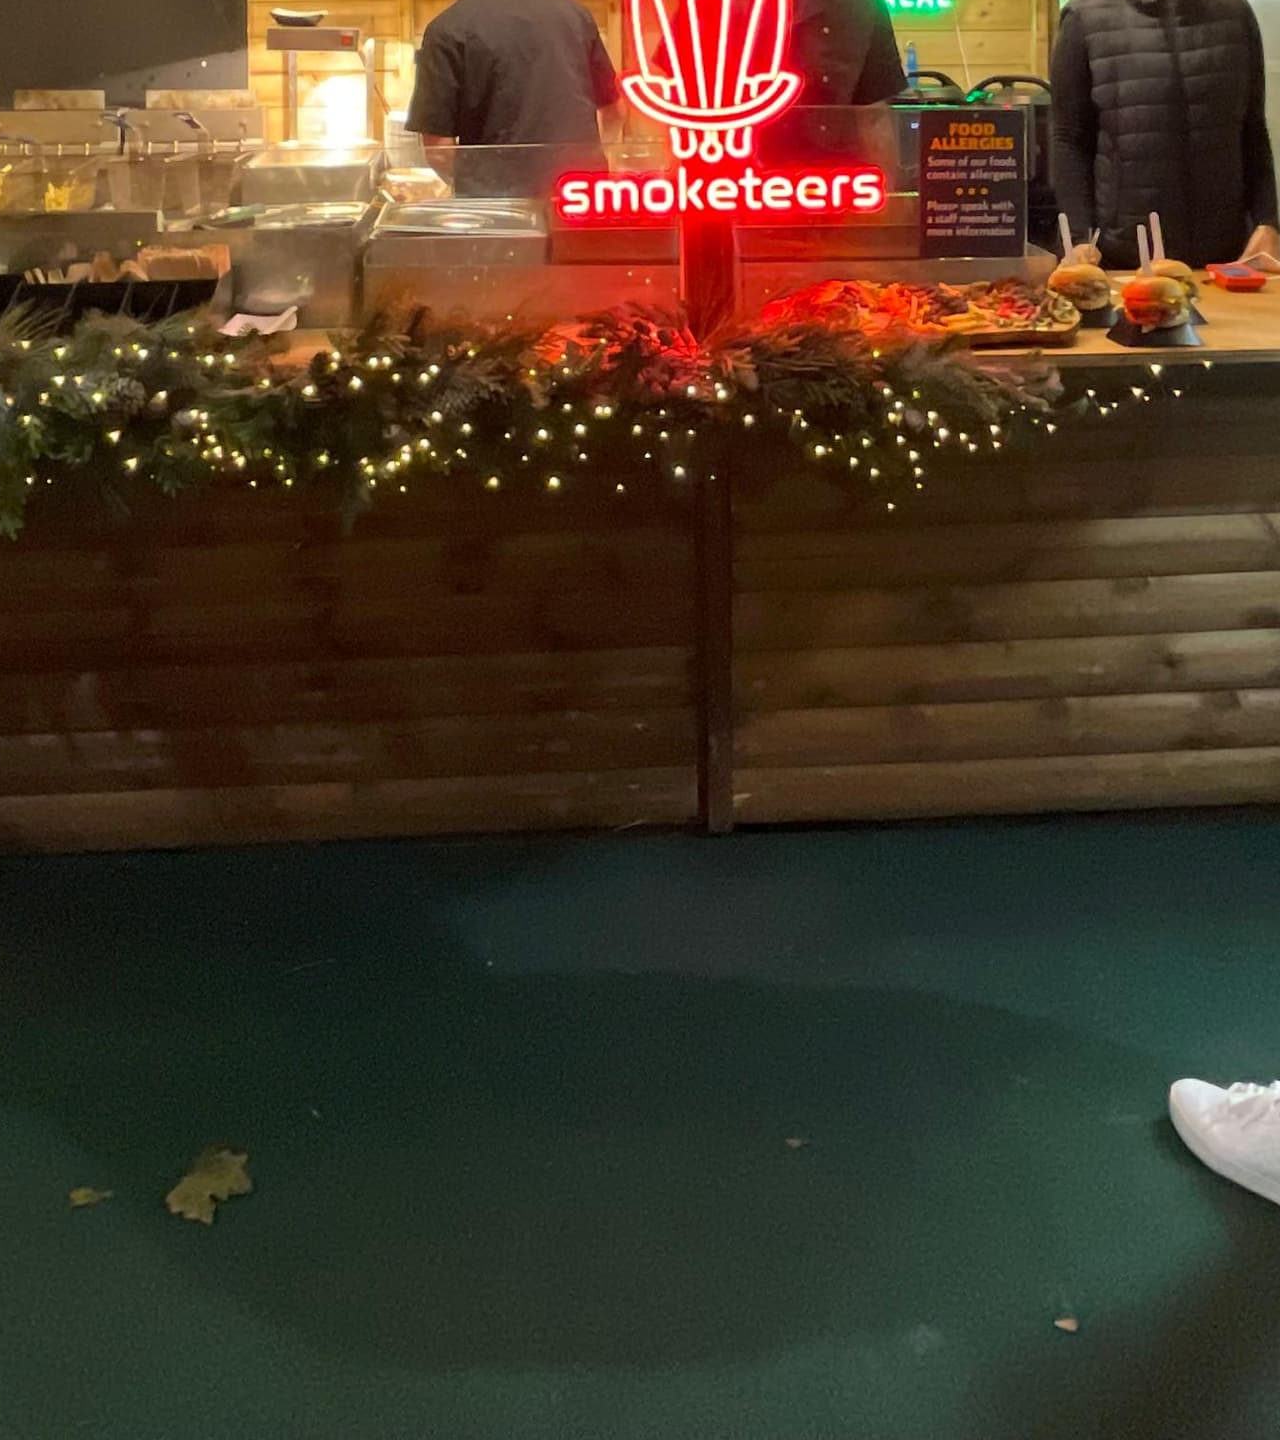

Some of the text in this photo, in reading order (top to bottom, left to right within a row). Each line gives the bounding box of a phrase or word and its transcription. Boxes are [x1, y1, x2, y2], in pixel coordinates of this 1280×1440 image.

[948, 122, 996, 137] FOOD
[929, 136, 1015, 150] ALLERGIES
[927, 156, 1017, 167] Some of our foods
[926, 168, 1018, 182] contain allergens
[561, 165, 882, 213] smoketeers
[960, 213, 999, 224] member
[1001, 213, 1016, 224] for
[955, 225, 1016, 237] information
